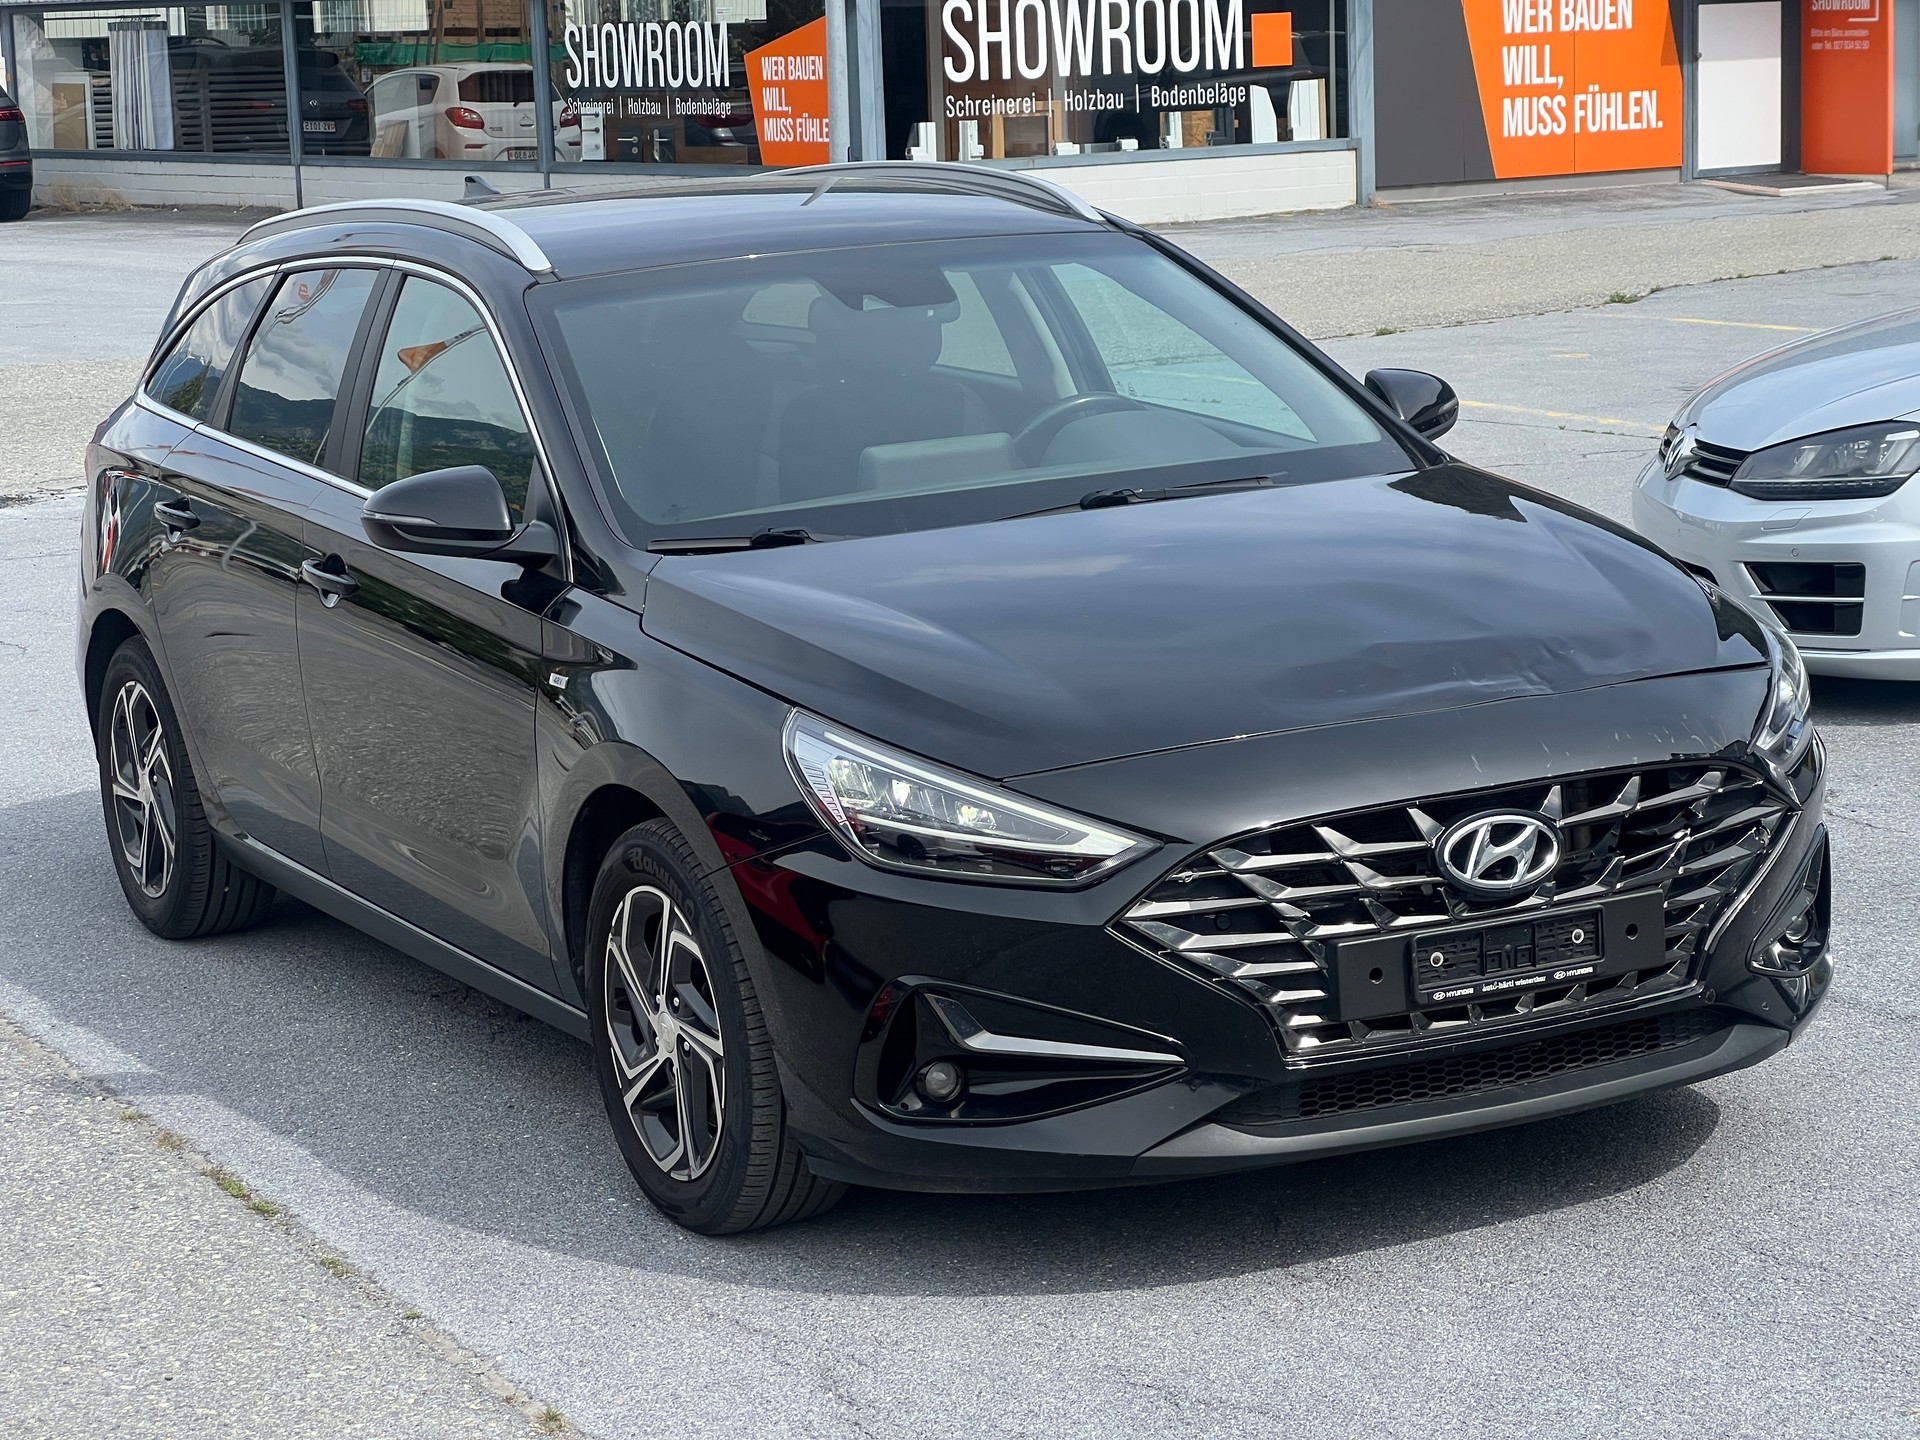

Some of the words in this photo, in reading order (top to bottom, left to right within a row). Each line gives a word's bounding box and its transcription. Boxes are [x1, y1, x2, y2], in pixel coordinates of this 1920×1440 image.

[1502, 0, 1552, 34] WER
[1560, 0, 1633, 32] BAUEN
[564, 21, 729, 88] SHOWROOM
[942, 0, 1245, 82] SHOWROOM
[761, 56, 785, 80] WER
[787, 55, 823, 80] BAUEN
[1502, 44, 1563, 90] WILL,
[567, 97, 614, 115] Schreinerei
[628, 97, 661, 115] Holzbau
[675, 97, 732, 118] Bodenbeläge
[762, 87, 791, 115] WILL,
[946, 92, 1036, 117] Schreinerei
[1064, 89, 1124, 112] Holzbau
[1151, 83, 1246, 107] Bodenbeläge
[1503, 95, 1567, 138] MUSS
[1574, 84, 1663, 133] FÜHLEN.
[763, 117, 794, 142] MUSS
[1445, 987, 1474, 998] HYUNDAI
[1566, 966, 1593, 977] HYUNDAI
